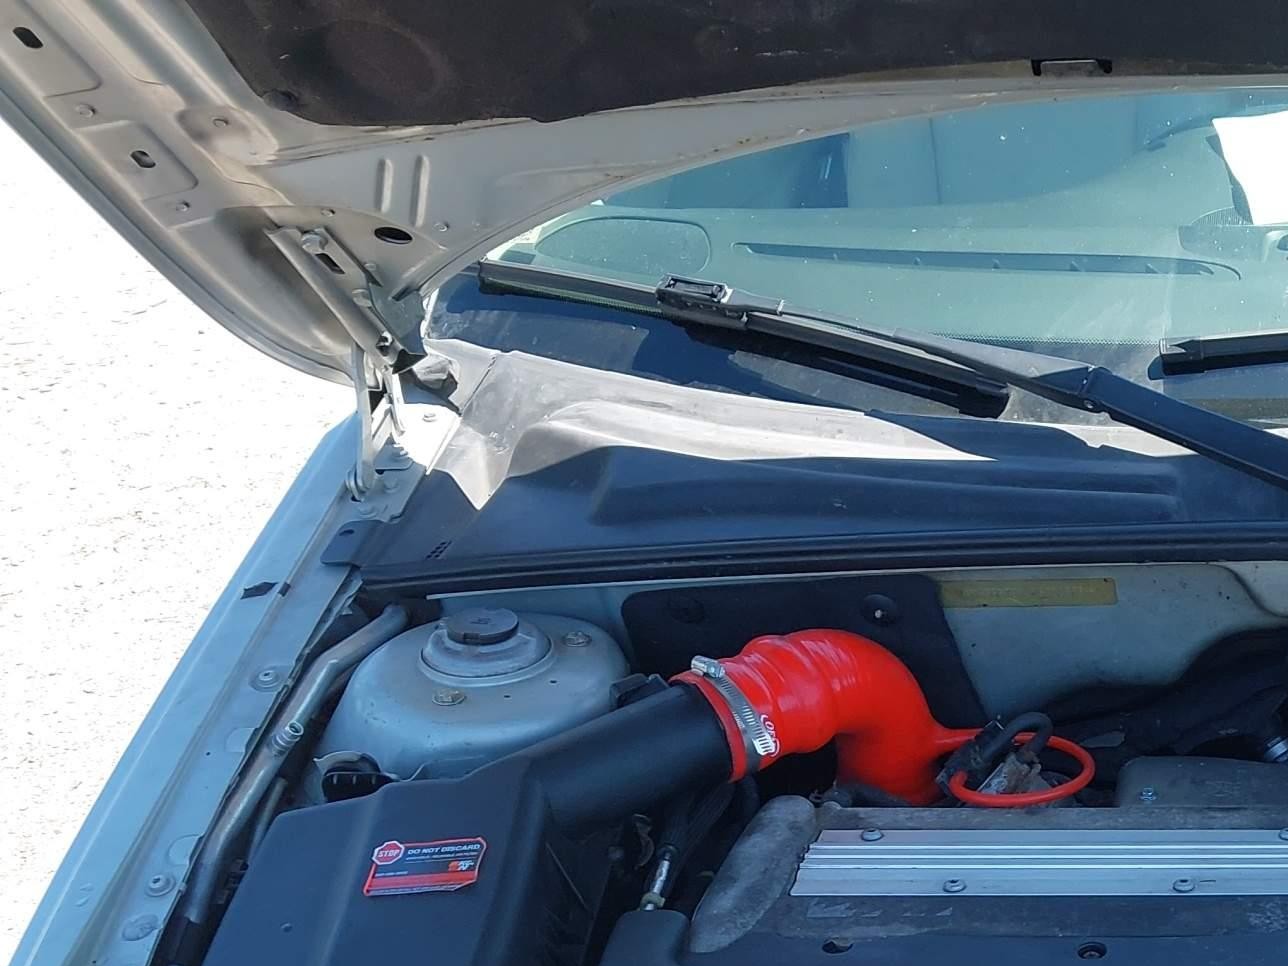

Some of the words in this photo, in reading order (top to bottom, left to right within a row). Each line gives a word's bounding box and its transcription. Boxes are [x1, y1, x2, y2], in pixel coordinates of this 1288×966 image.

[377, 848, 400, 858] STOP
[422, 846, 441, 855] NOT
[440, 843, 481, 853] DISCARD
